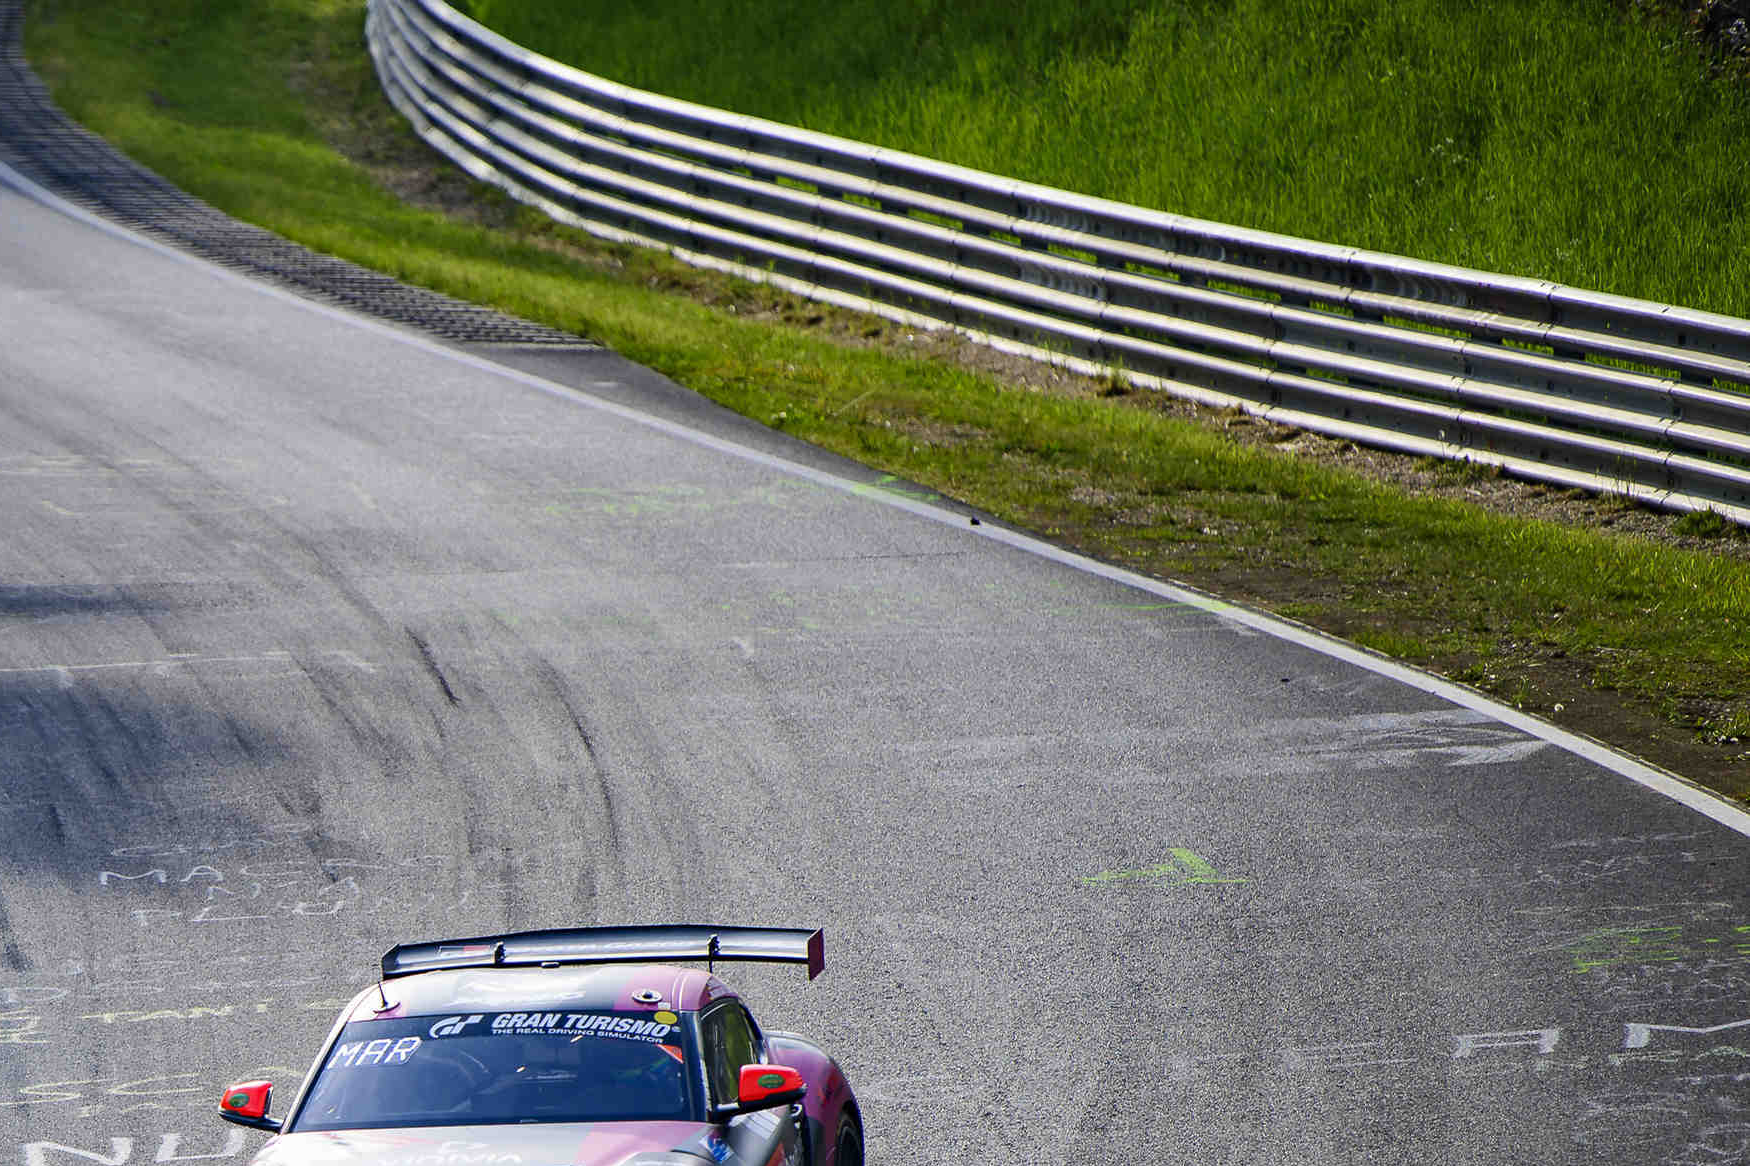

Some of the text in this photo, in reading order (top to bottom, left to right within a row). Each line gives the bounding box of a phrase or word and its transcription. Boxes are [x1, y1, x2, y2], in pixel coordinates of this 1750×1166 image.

[492, 1013, 671, 1037] GRAN TURISMO
[597, 1031, 664, 1044] SIMULATOR
[326, 1036, 423, 1070] MAR
